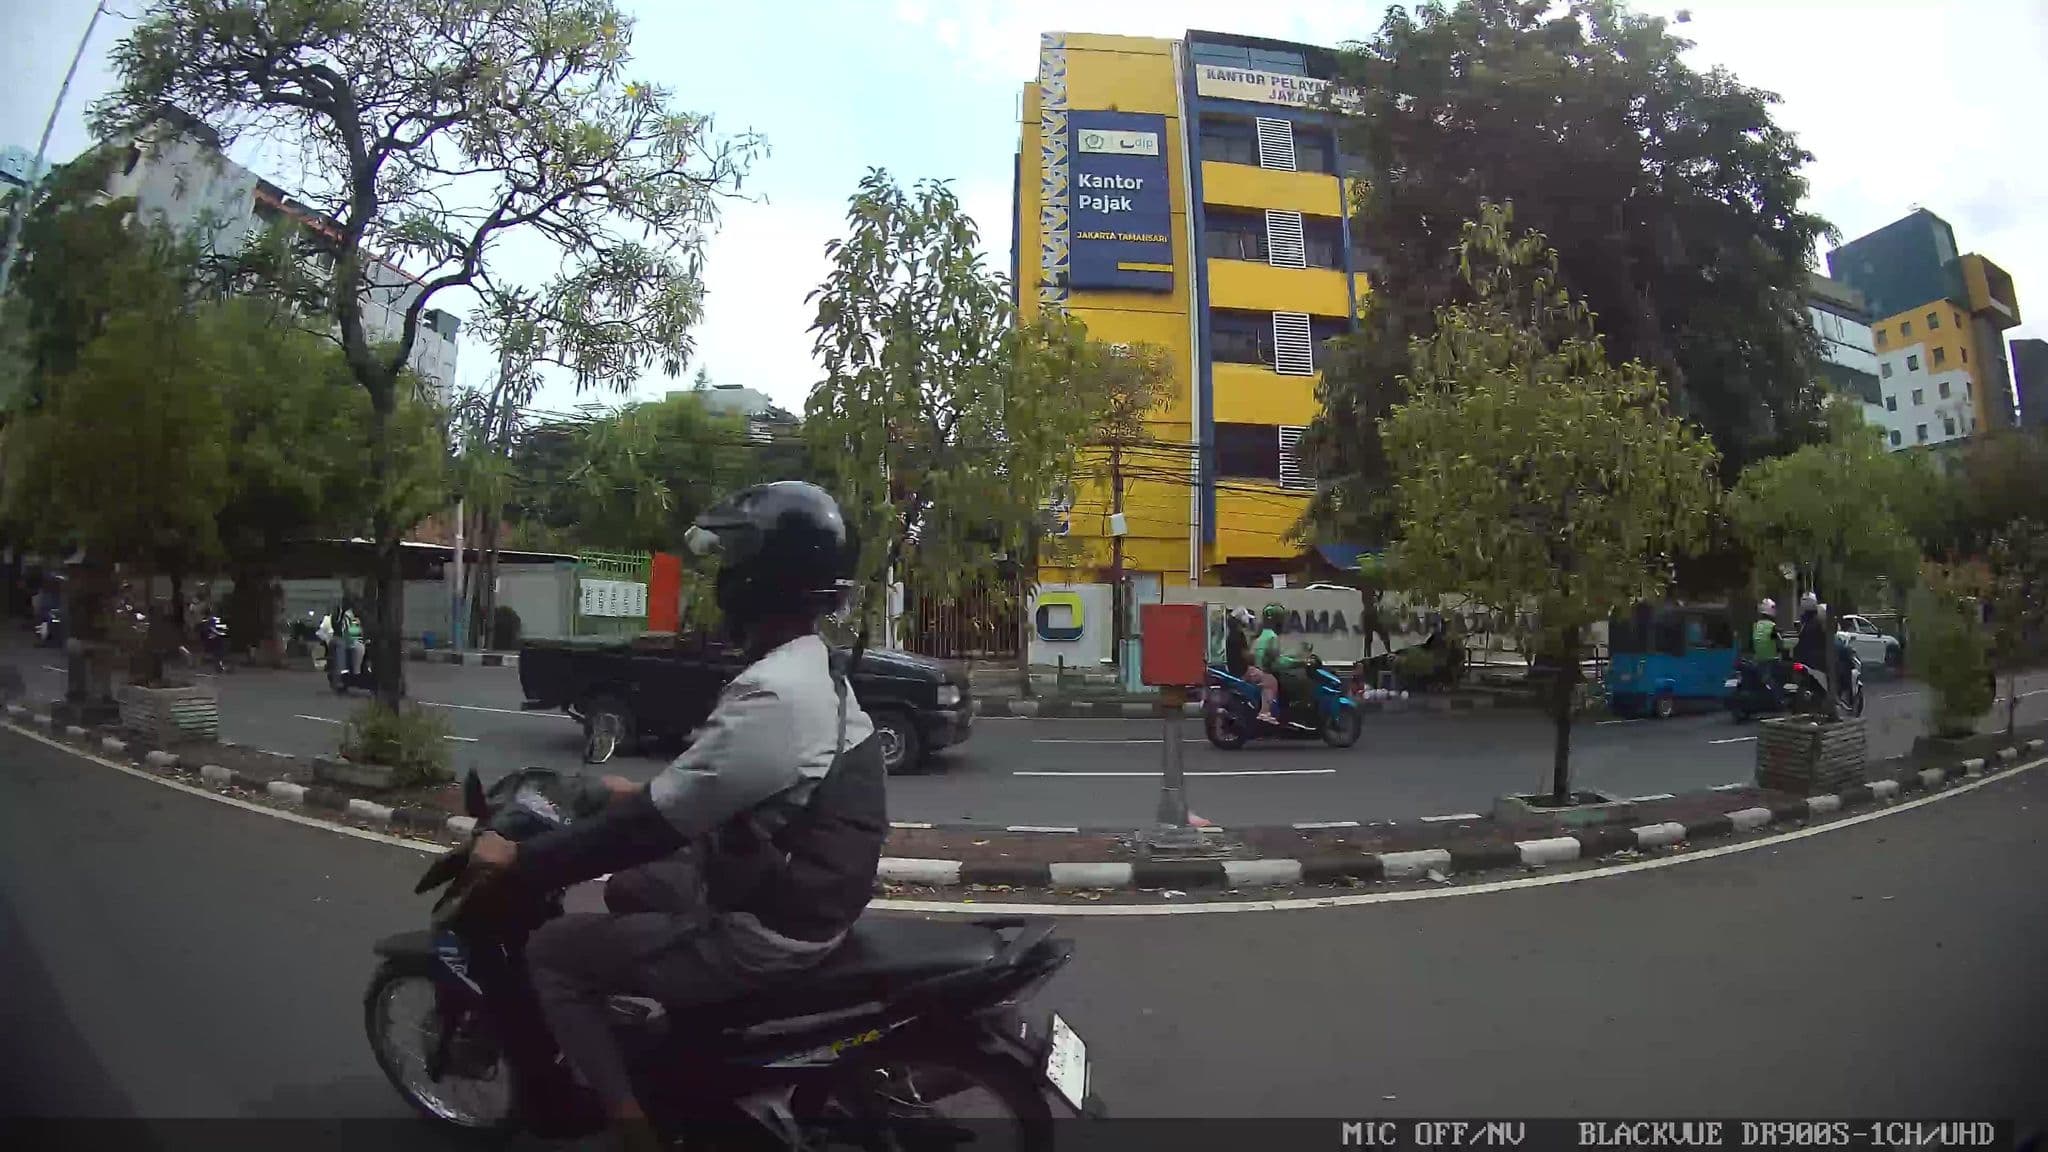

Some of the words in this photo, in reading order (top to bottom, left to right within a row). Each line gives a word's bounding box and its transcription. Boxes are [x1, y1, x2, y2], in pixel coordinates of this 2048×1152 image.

[1207, 69, 1265, 85] KANTOR
[1079, 173, 1144, 190] Kantor
[1079, 194, 1132, 213] Pajak
[1076, 231, 1117, 240] JAKARTA
[1118, 233, 1168, 243] TAMANSARI
